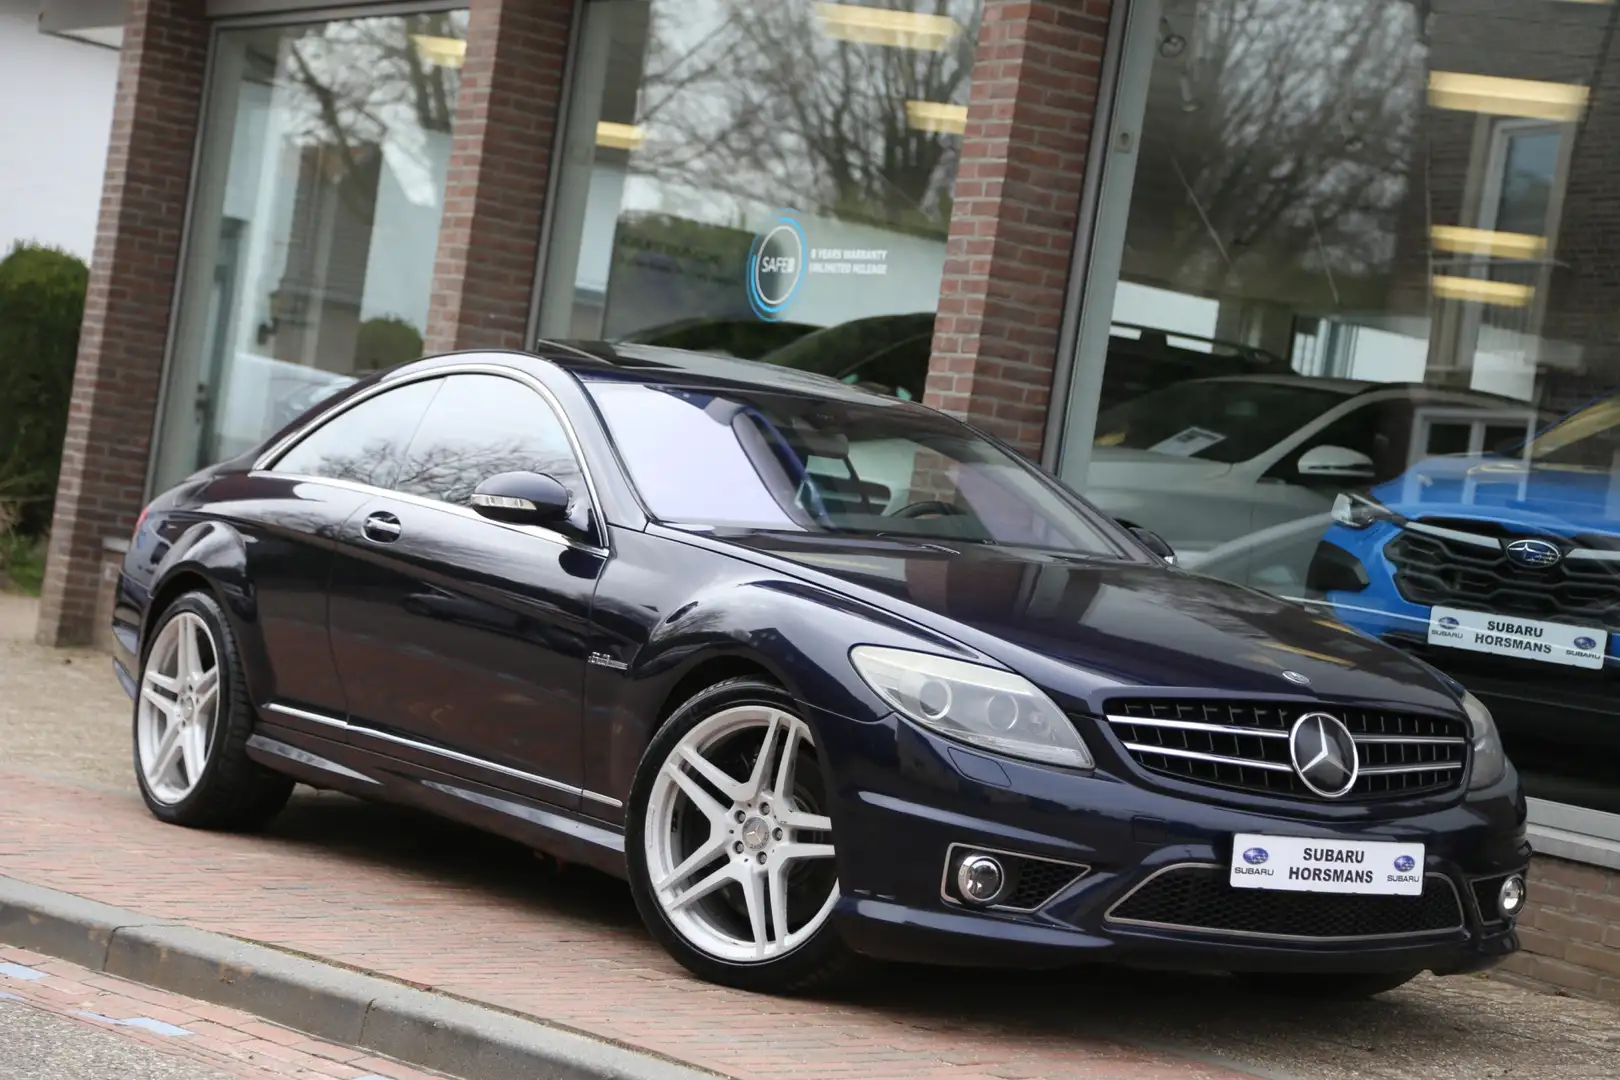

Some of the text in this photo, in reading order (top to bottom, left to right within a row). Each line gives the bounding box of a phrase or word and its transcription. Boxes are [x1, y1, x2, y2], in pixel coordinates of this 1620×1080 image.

[818, 248, 842, 260] YEARS
[843, 249, 887, 261] WARRANTY
[809, 262, 887, 275] UNLIMITED MILEAGE
[1431, 629, 1463, 639] SUBARU
[1487, 620, 1543, 638] SUBARU
[1474, 633, 1552, 654] HORSMANS
[1565, 649, 1601, 660] SUBARU
[1303, 847, 1364, 864] SUBARU
[1234, 867, 1274, 876] SUBARU
[1288, 866, 1373, 884] HORSMANS
[1387, 874, 1420, 883] SUBARU
